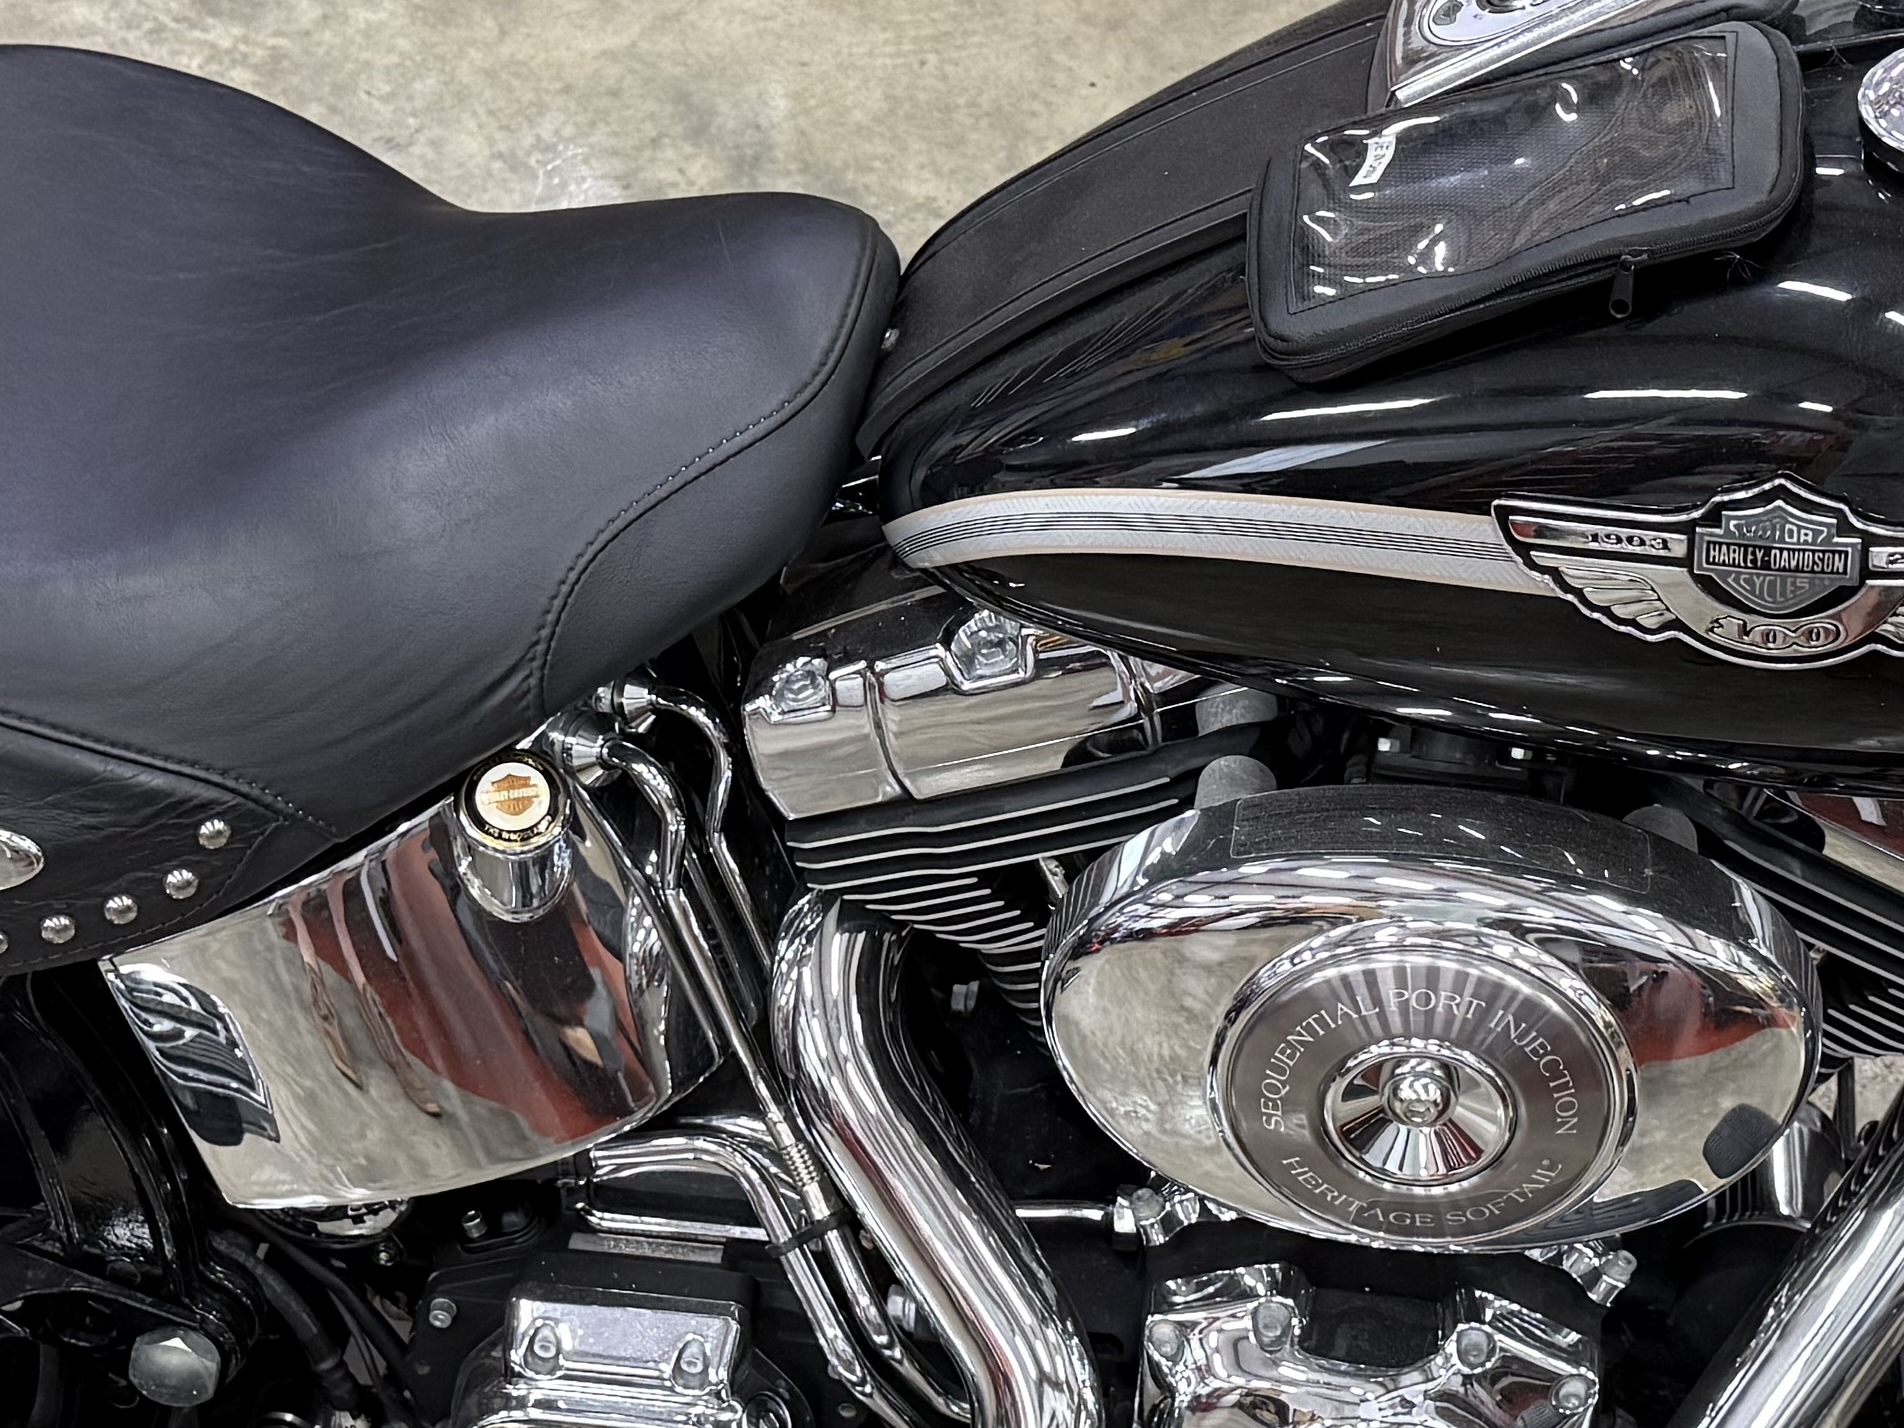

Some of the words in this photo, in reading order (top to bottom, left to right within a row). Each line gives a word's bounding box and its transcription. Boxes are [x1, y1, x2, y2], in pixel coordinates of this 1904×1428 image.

[1586, 531, 1671, 553] 1903
[1708, 542, 1847, 575] HARLEY-DAVIDSON
[1744, 575, 1810, 603] CYCLES
[1707, 615, 1843, 650] 100
[1261, 991, 1380, 1133] SEQUENTIAL
[1389, 988, 1486, 1020] PORT
[1490, 1009, 1578, 1136] INJECTION
[1280, 1155, 1436, 1229] HERITAGE
